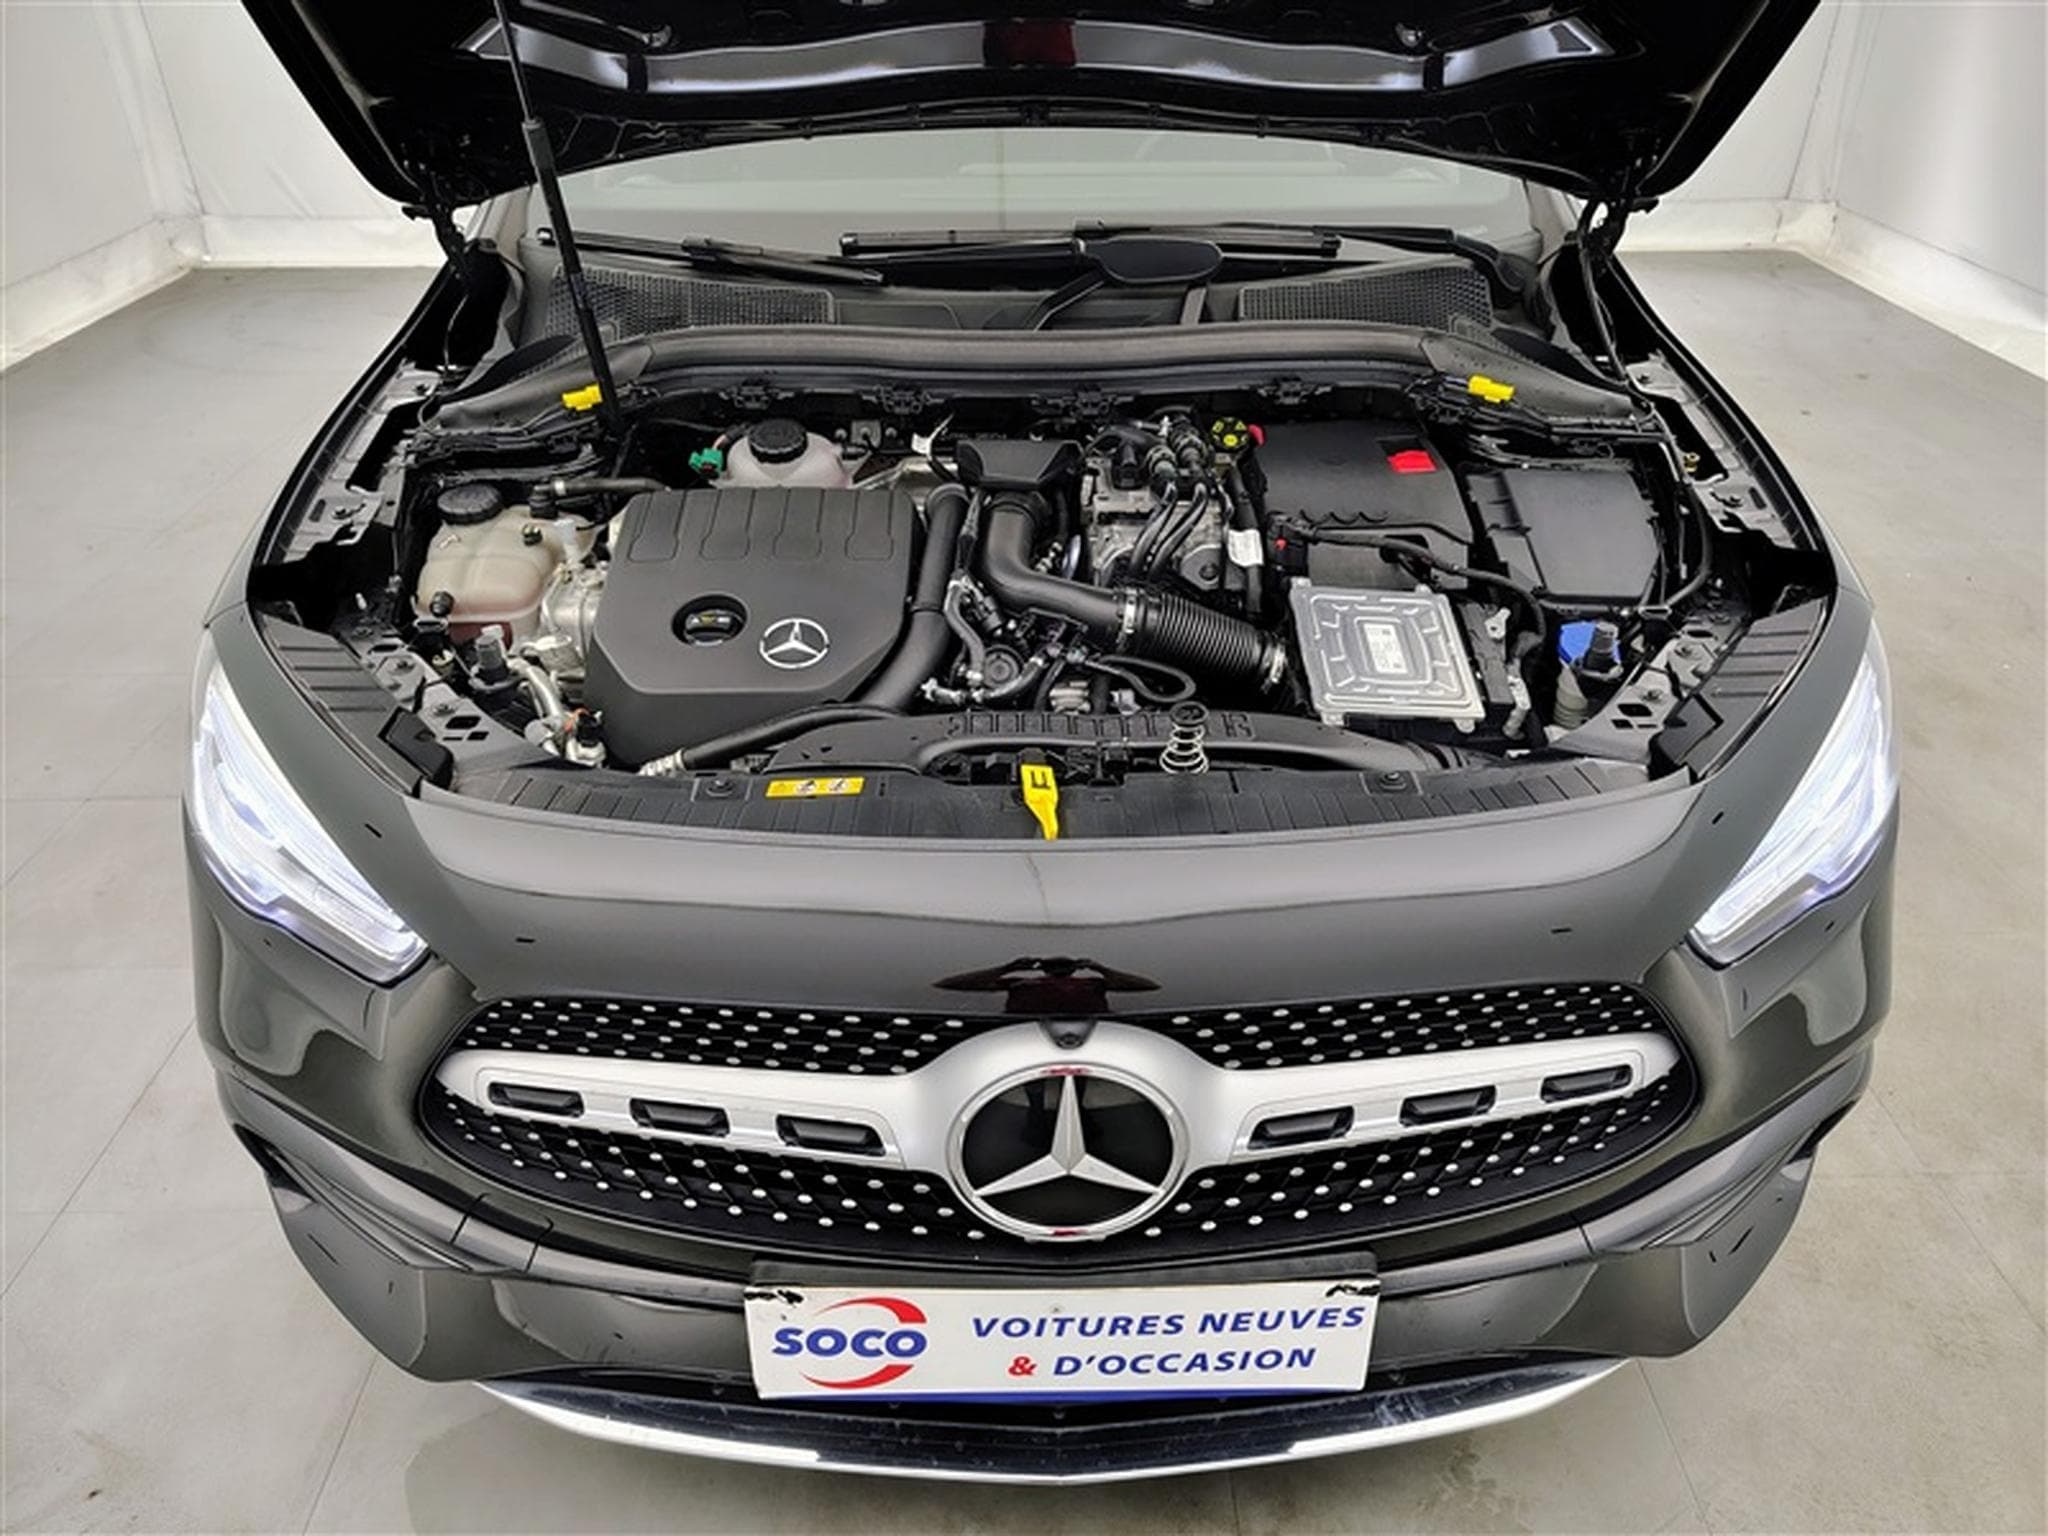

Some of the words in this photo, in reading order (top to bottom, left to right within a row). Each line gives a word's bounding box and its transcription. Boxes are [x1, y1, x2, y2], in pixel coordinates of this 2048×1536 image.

[973, 1315, 1184, 1338] VOITURES
[1198, 1306, 1366, 1334] NEUVES
[772, 1327, 928, 1358] SOCO
[1008, 1356, 1037, 1377] &
[1053, 1348, 1316, 1376] D'OCCASION
